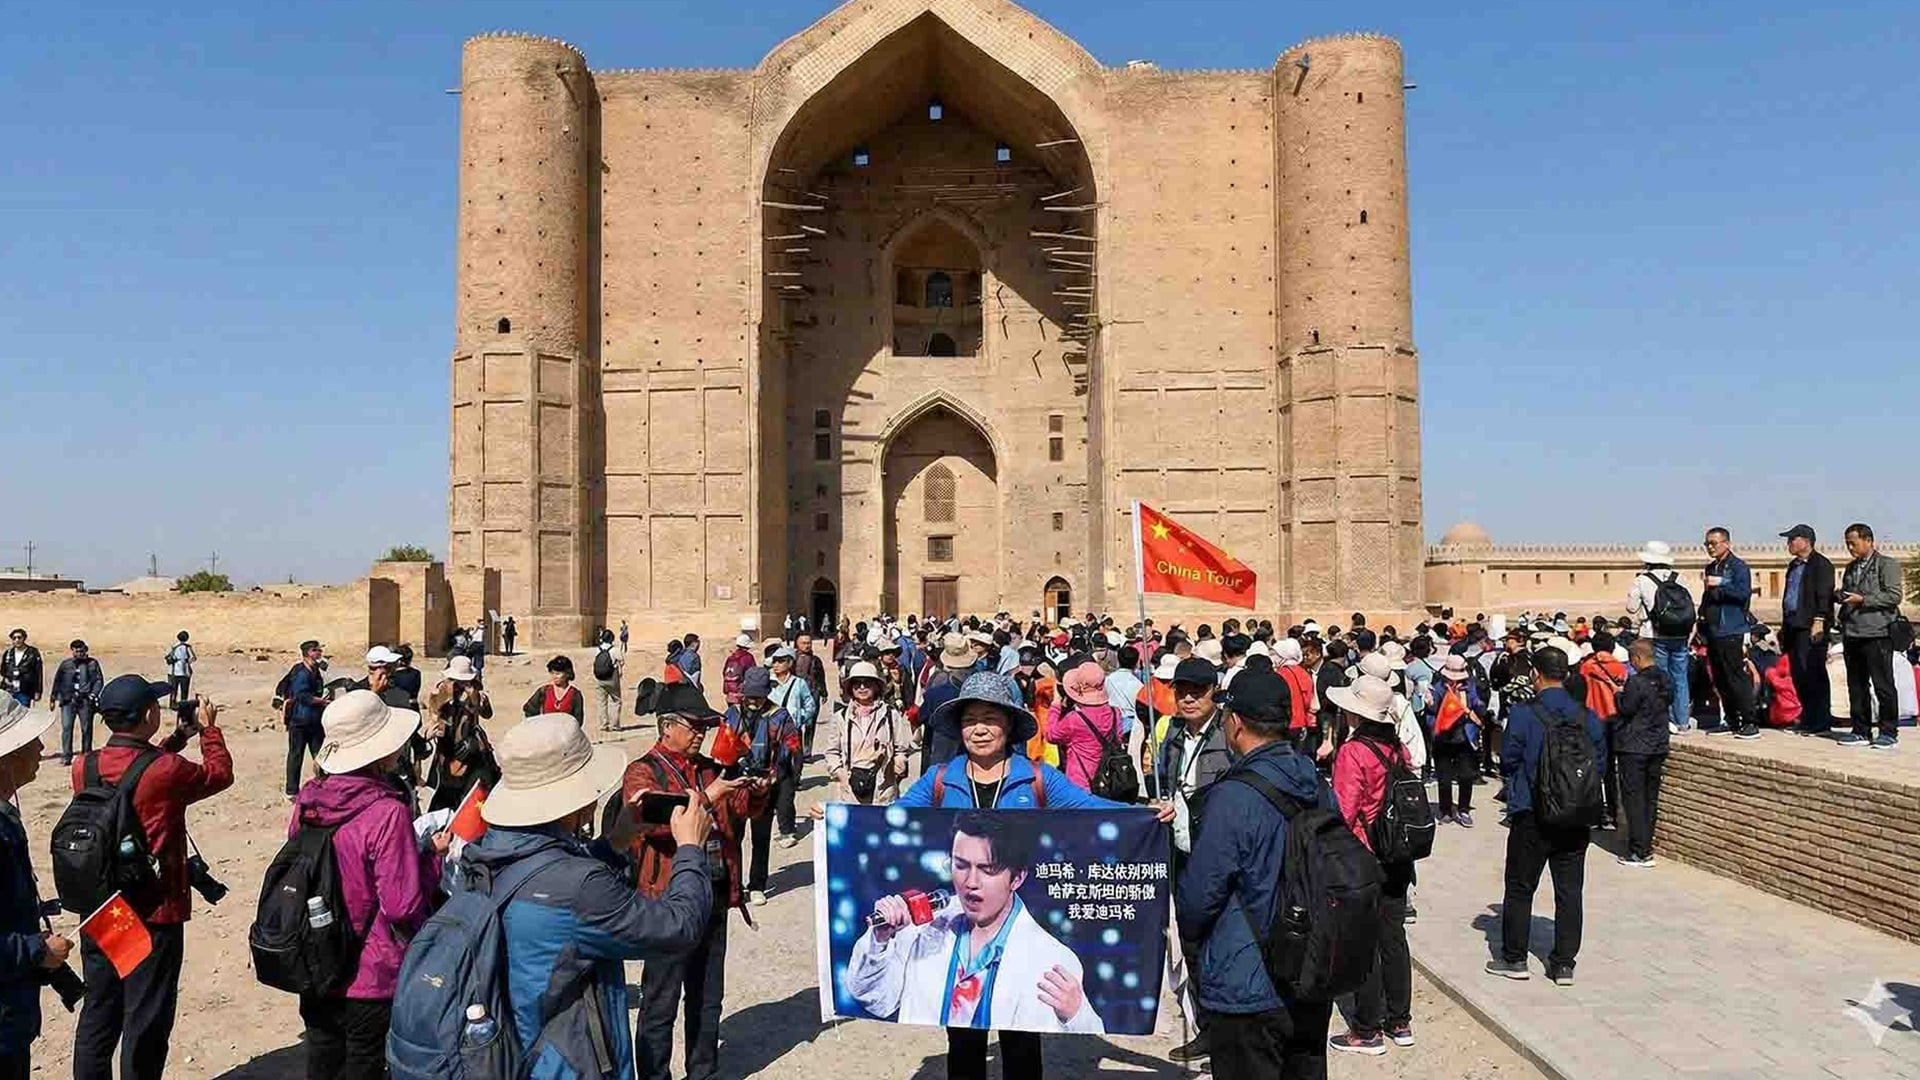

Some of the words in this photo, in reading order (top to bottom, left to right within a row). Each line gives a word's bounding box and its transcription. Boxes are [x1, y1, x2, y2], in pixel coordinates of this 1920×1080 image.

[1156, 560, 1201, 581] China
[1206, 570, 1243, 588] Tour
[1068, 903, 1136, 920] 我爱迪玛希
